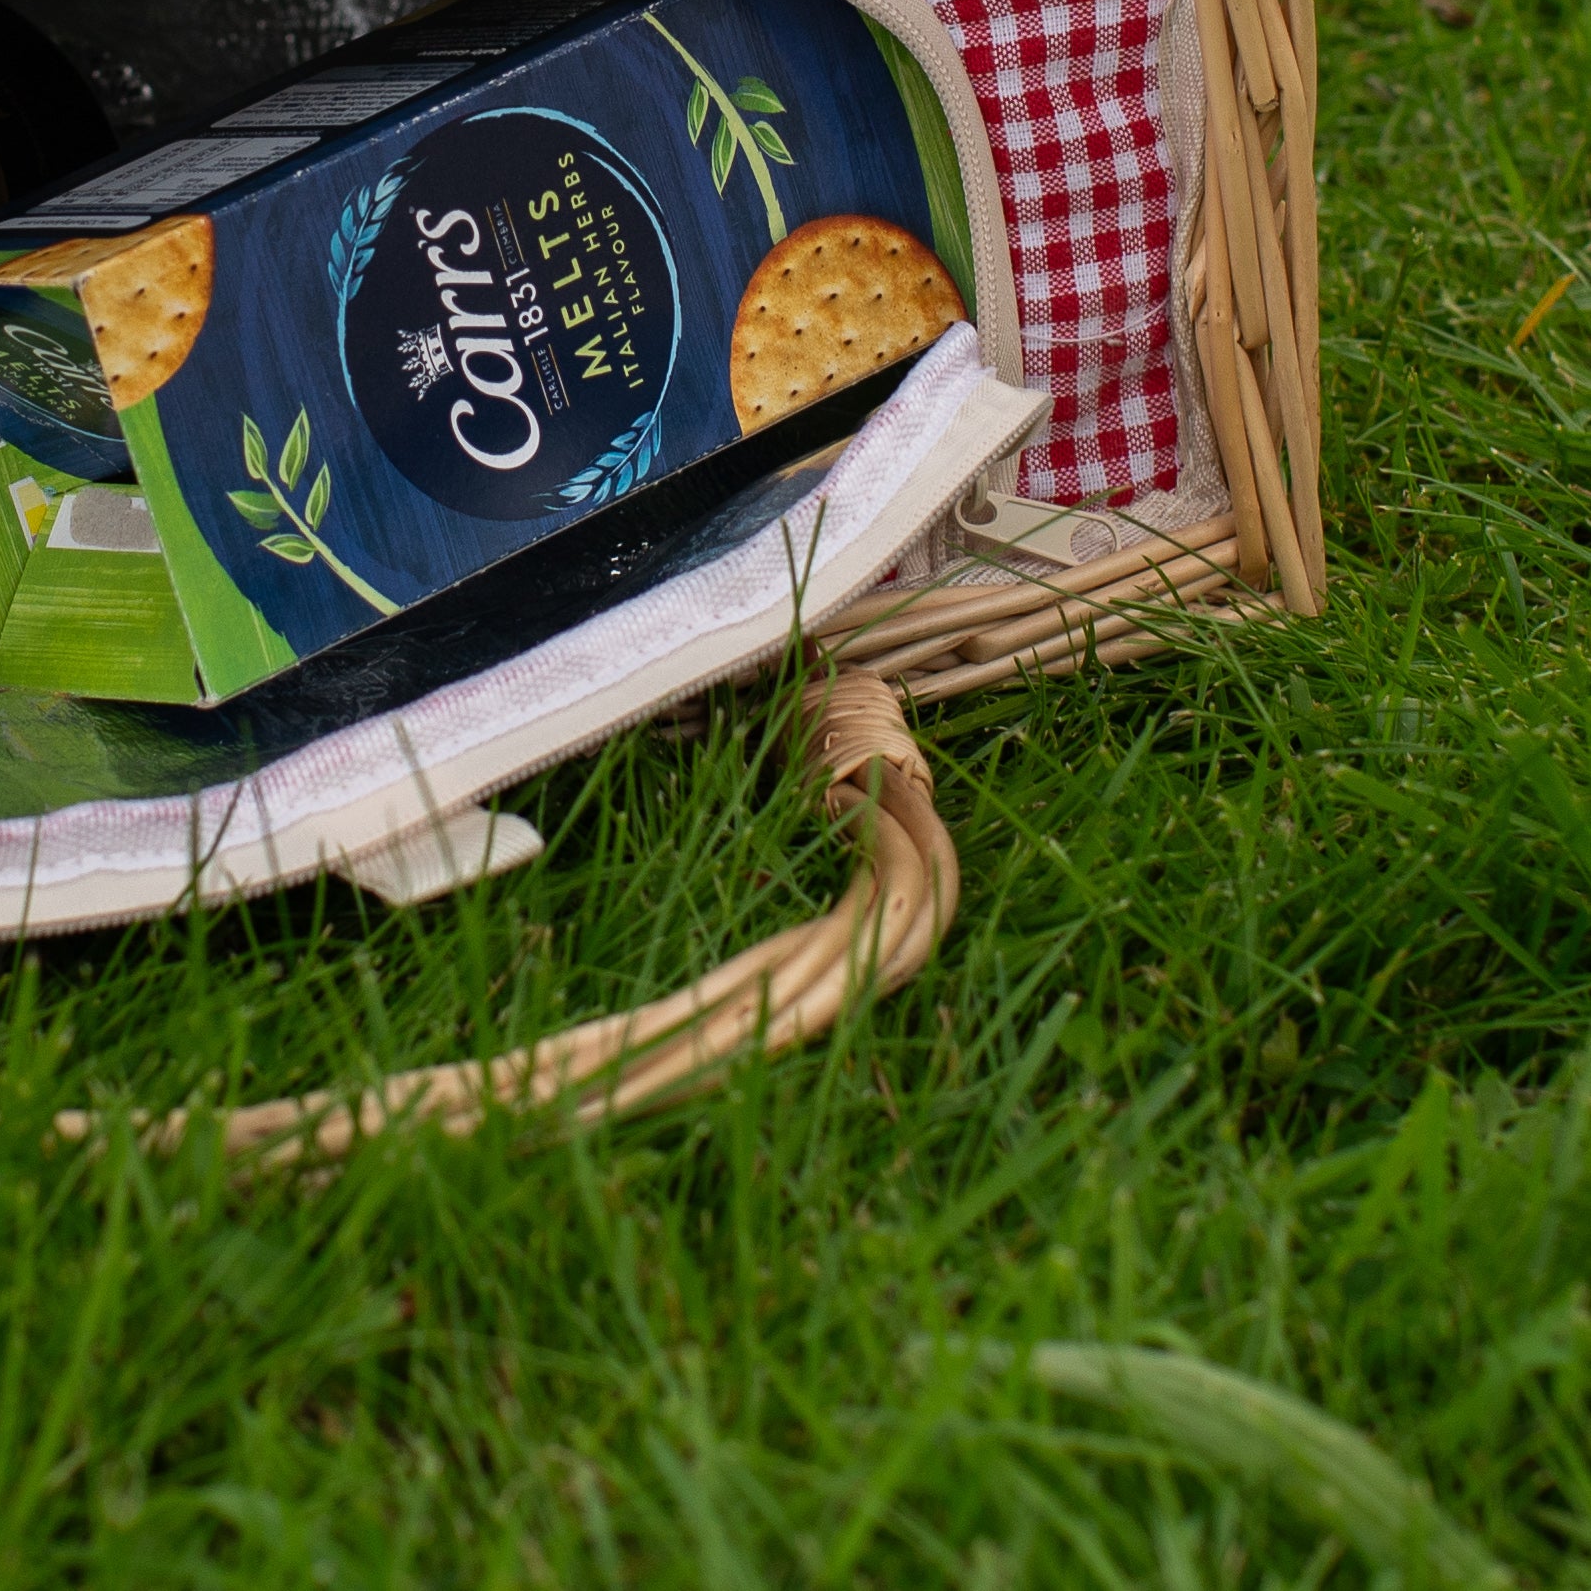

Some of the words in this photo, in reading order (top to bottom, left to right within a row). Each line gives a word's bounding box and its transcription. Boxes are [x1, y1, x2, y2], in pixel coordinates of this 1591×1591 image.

[493, 204, 517, 266] CUMBRIA
[559, 152, 601, 253] HERBS
[506, 267, 549, 347] 1831
[529, 190, 613, 380] MELTS
[601, 204, 645, 315] FLAVOUR
[32, 361, 75, 388] 1831
[415, 209, 541, 470] Carr's
[594, 266, 645, 389] ITALIAN
[537, 349, 563, 411] CARLISLE
